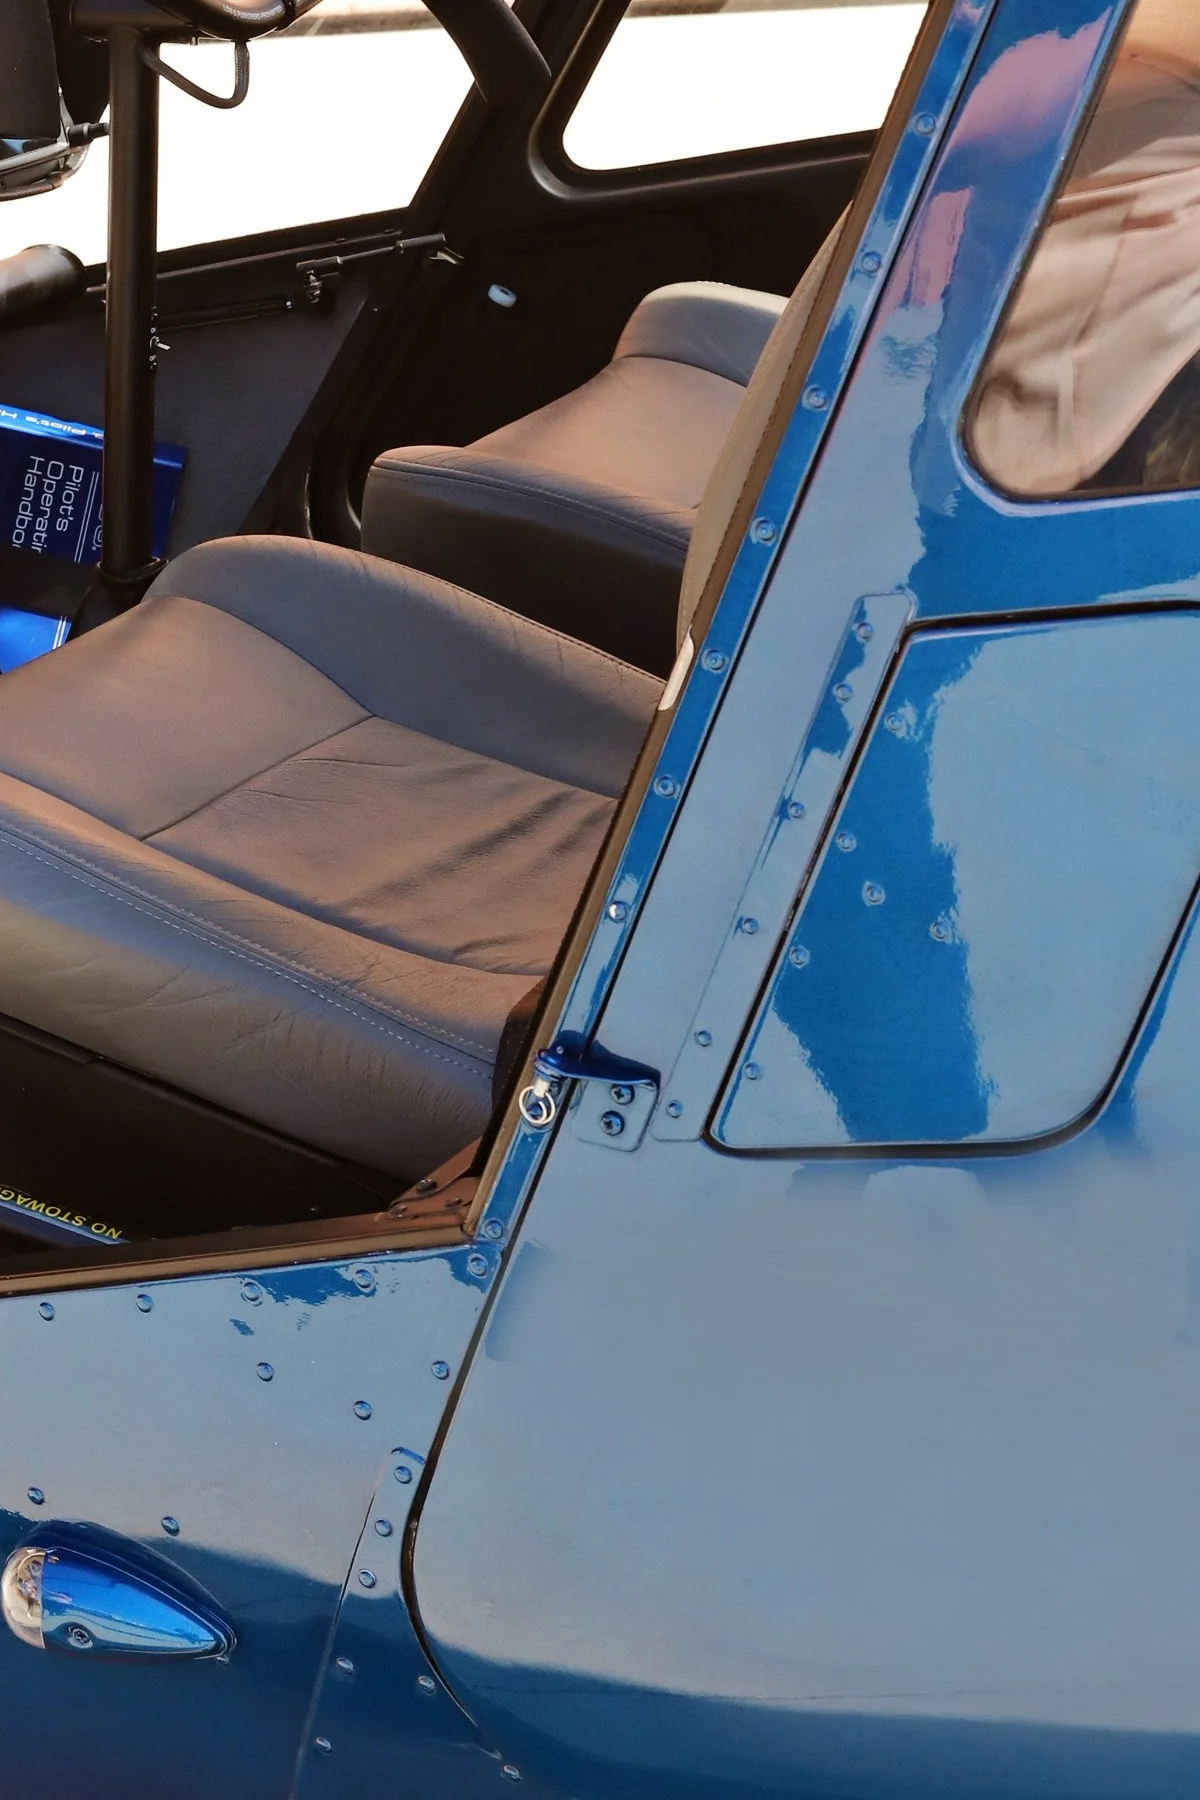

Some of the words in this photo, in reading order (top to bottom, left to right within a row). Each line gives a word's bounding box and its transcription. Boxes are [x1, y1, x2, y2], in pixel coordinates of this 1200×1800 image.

[25, 416, 87, 436] Pilot's
[11, 455, 46, 548] Handbo
[55, 464, 85, 533] Pilot's
[91, 1222, 123, 1240] NO
